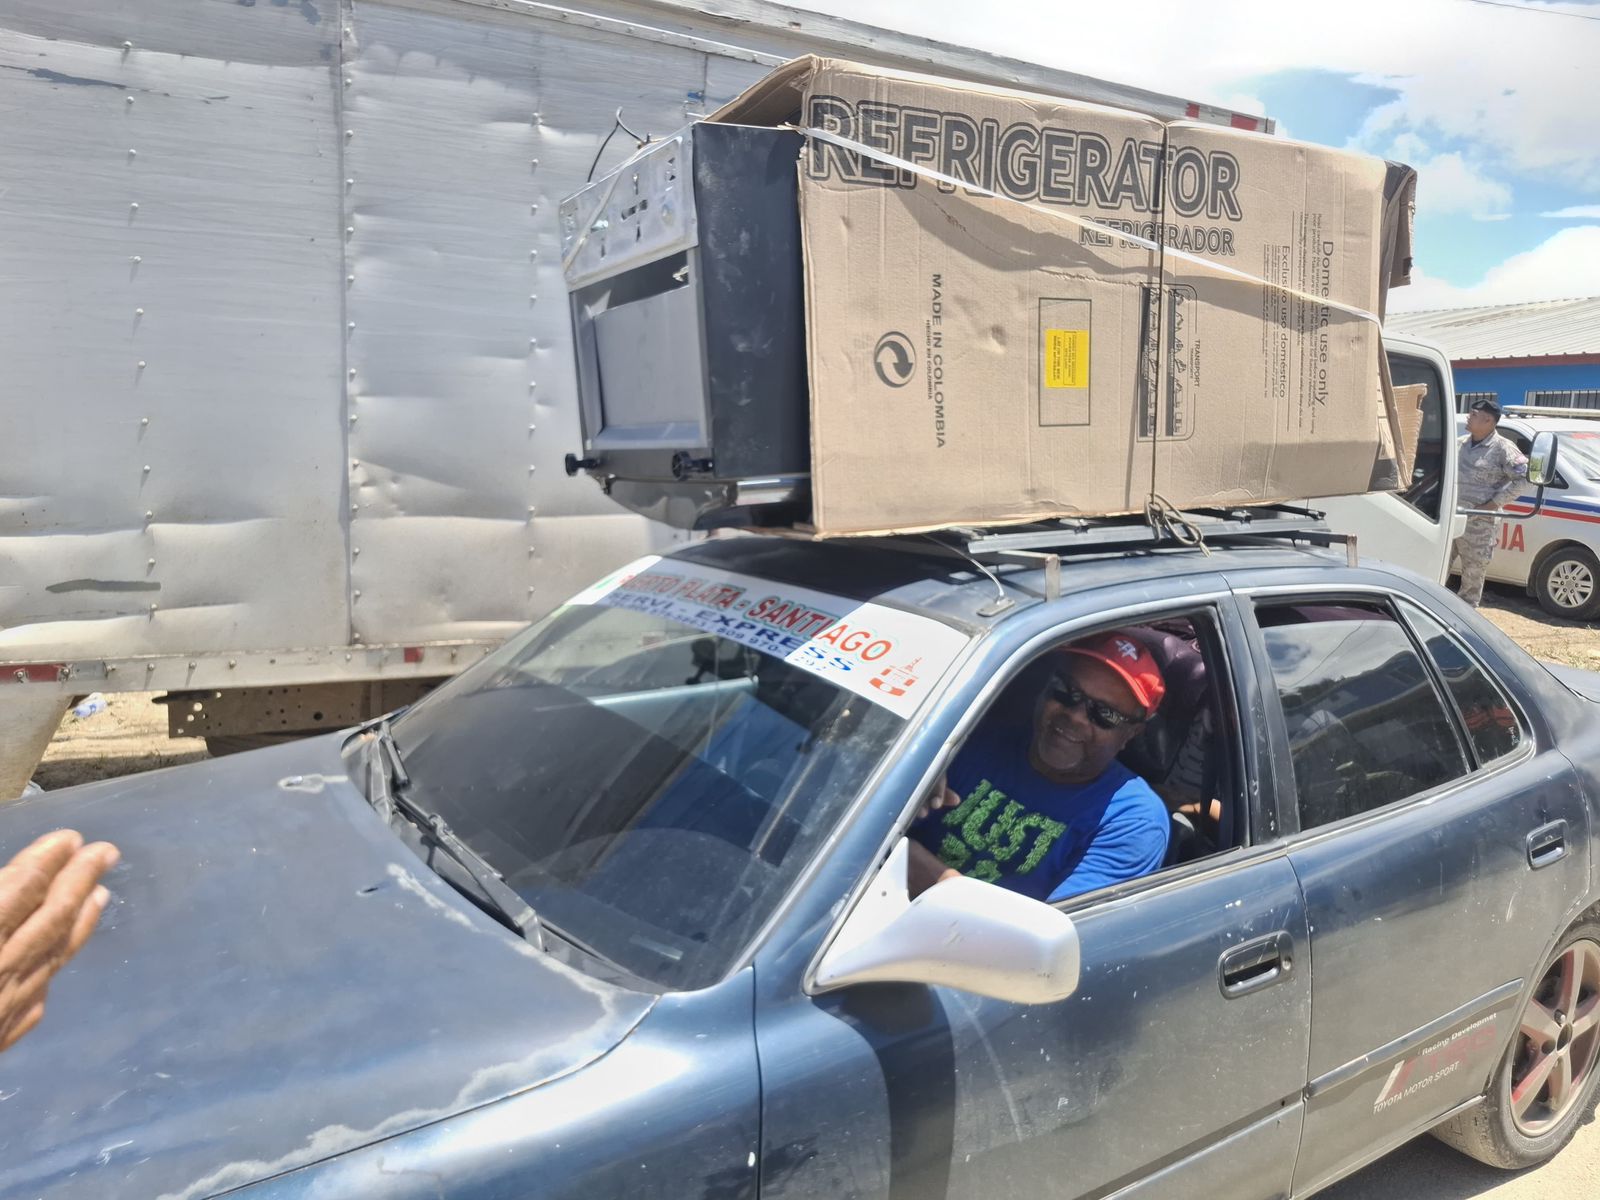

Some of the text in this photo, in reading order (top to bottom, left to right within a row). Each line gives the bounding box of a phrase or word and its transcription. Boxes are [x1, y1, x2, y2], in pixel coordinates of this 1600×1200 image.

[807, 95, 1241, 221] REFRIGERATOR
[1079, 216, 1235, 255] REFRIGERADOR
[1281, 246, 1290, 303] Exclusivo
[1315, 241, 1334, 408] Dometic use only
[932, 274, 945, 448] MADE IN COLOMBIA
[1280, 333, 1288, 398] doméstico
[748, 598, 892, 661] SANTIAGO
[1422, 1038, 1450, 1056] Racing
[1372, 1060, 1460, 1115] TOYOTA MOTOR SPORT
